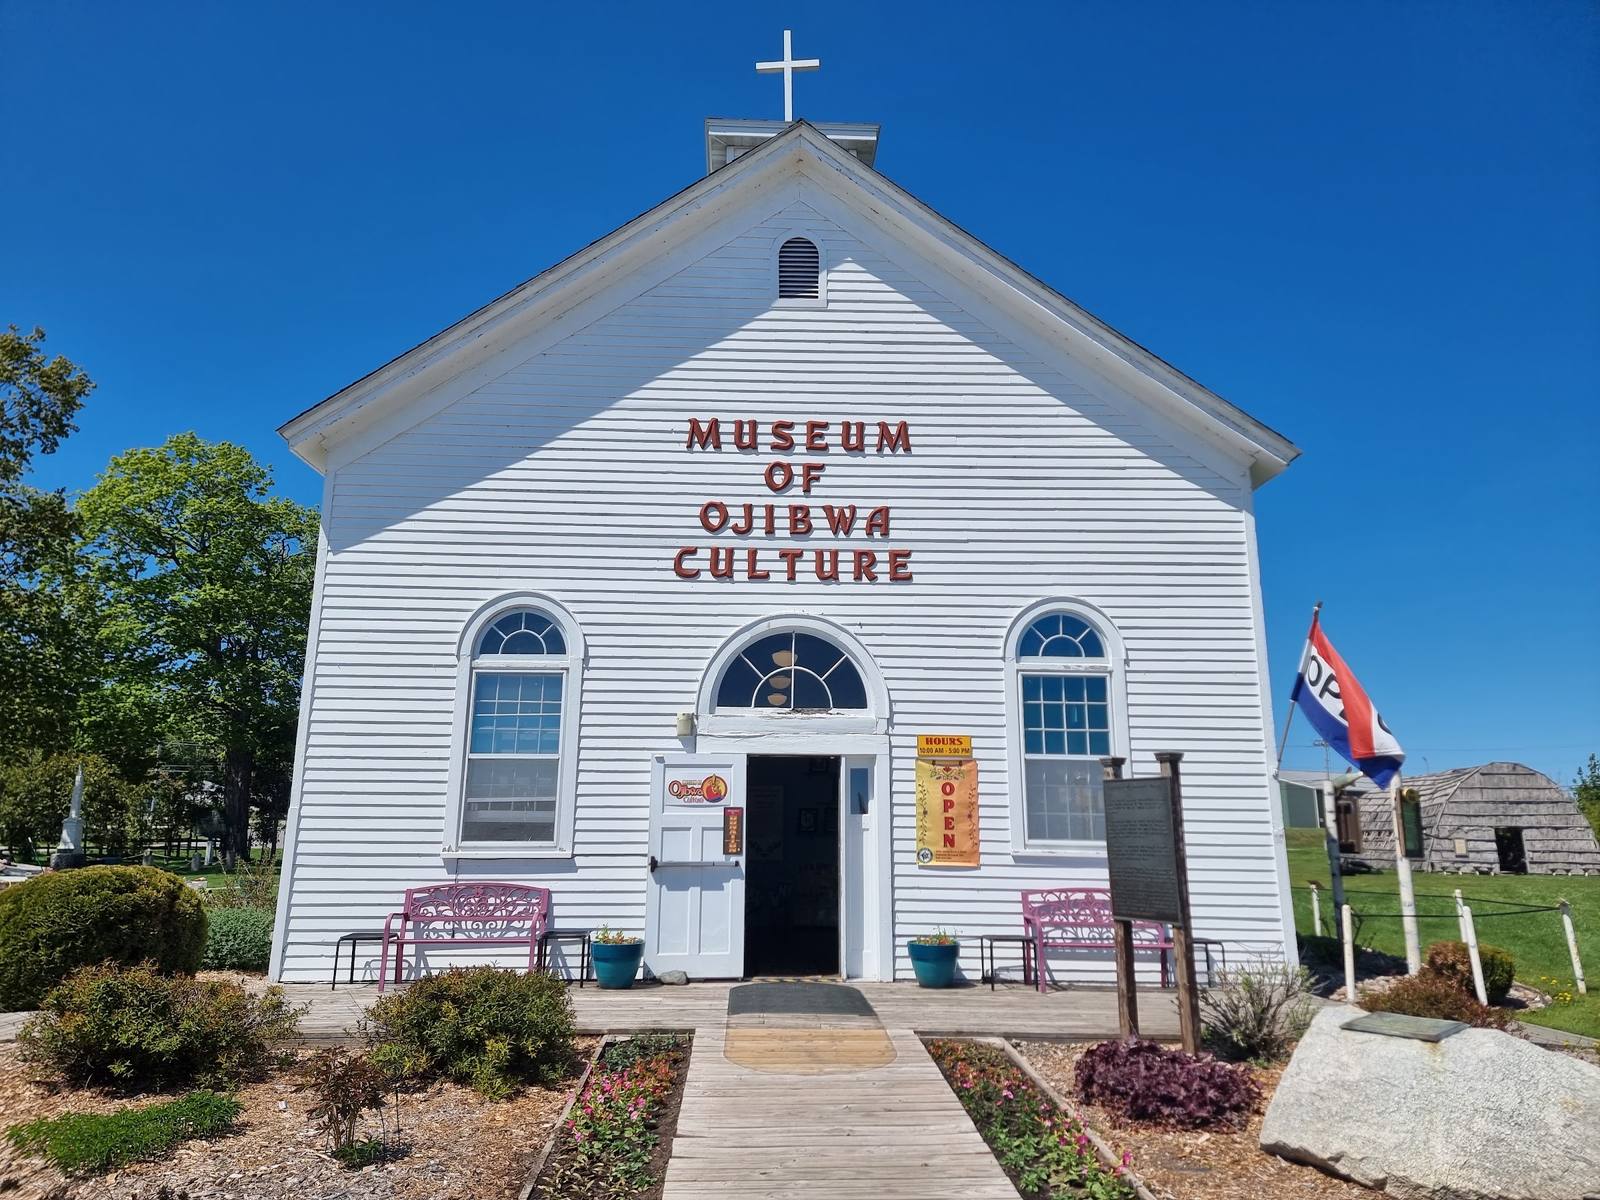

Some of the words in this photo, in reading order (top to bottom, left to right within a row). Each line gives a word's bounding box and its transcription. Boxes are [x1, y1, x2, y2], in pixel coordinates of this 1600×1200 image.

[686, 417, 912, 453] MUSEUM
[764, 461, 825, 494] OF
[699, 501, 890, 538] OJIBWA
[673, 546, 913, 582] CULTURE
[925, 737, 964, 746] HOURS
[941, 781, 956, 848] OPEN
